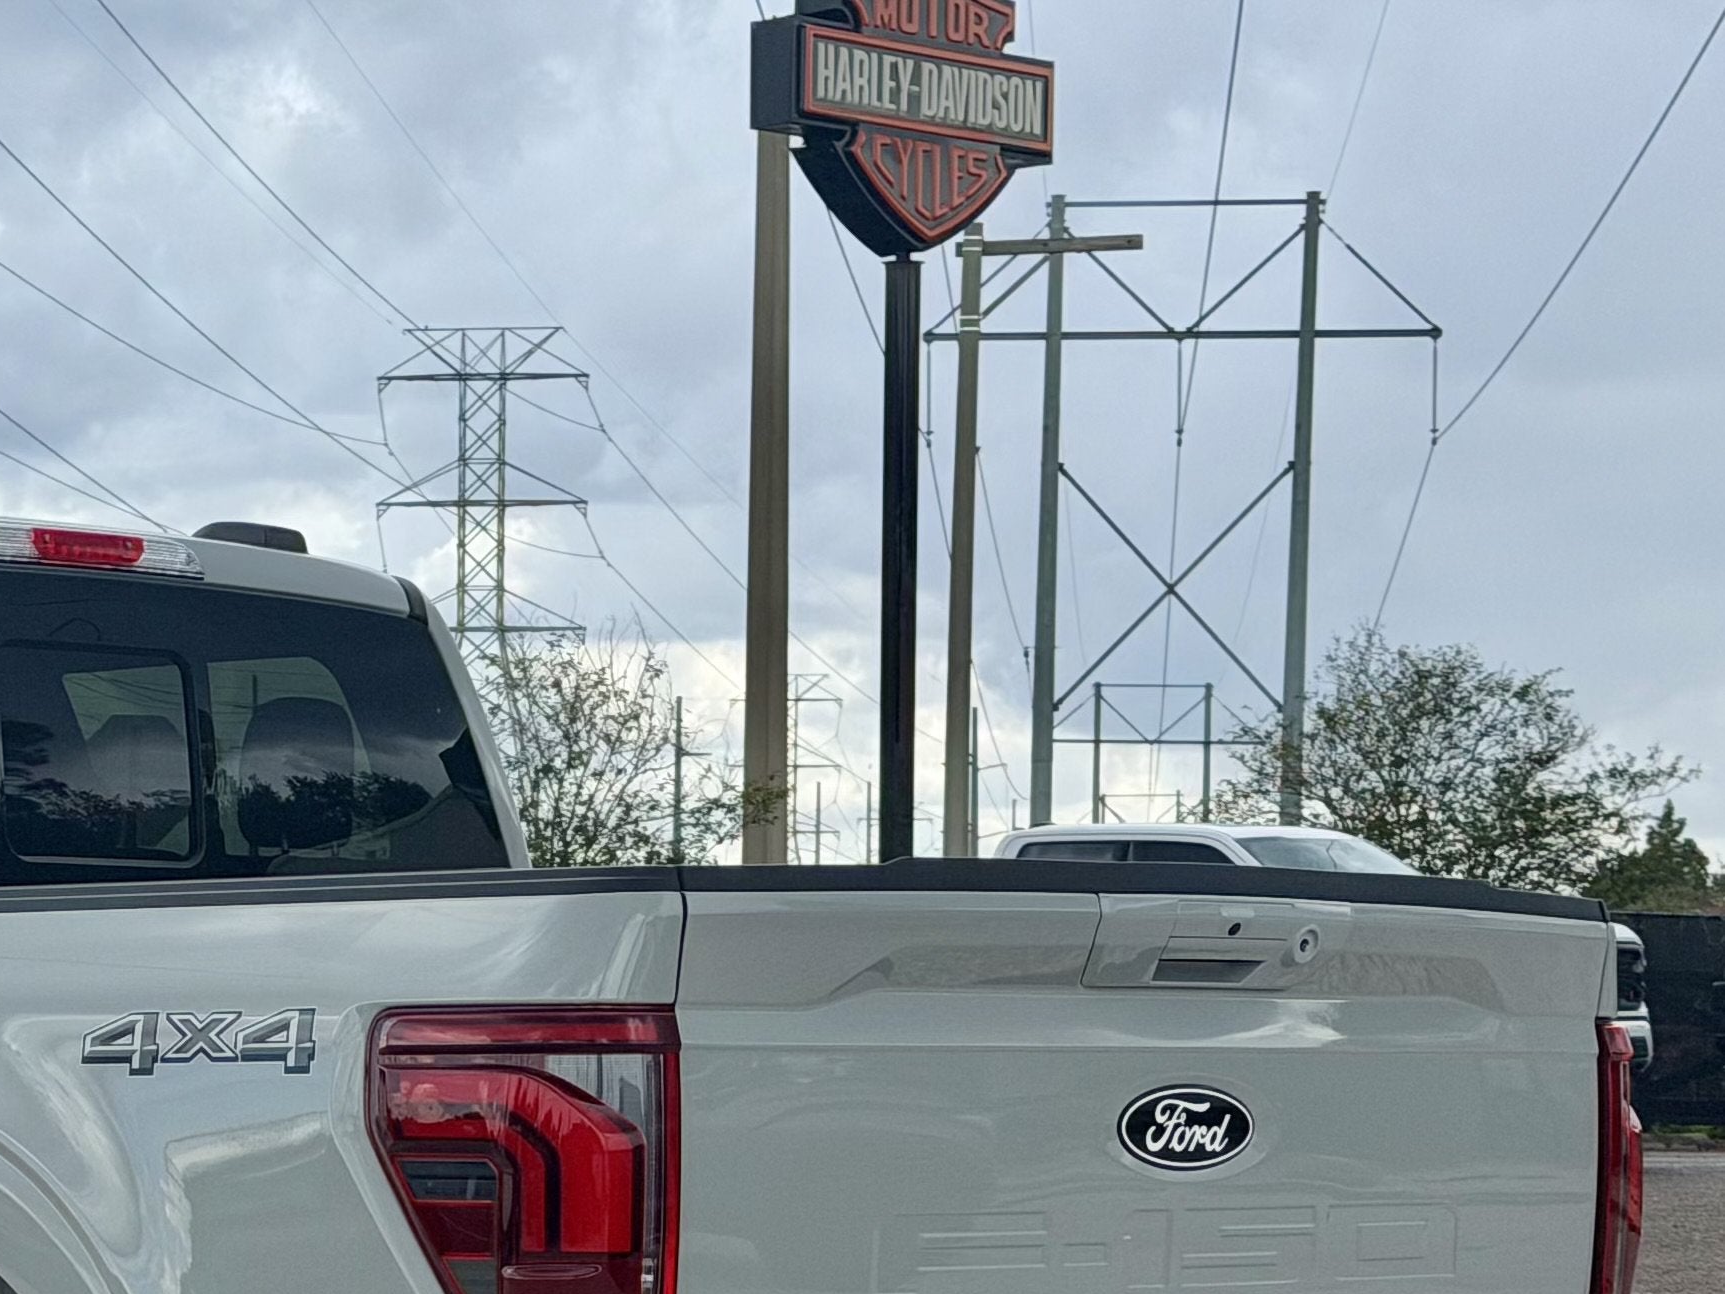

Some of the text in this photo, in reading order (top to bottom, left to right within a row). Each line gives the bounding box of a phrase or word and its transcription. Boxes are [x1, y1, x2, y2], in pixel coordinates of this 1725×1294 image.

[816, 41, 1045, 136] HARLEY-DAVIDSON
[872, 134, 989, 221] CYCLES
[1145, 1098, 1231, 1154] Ford
